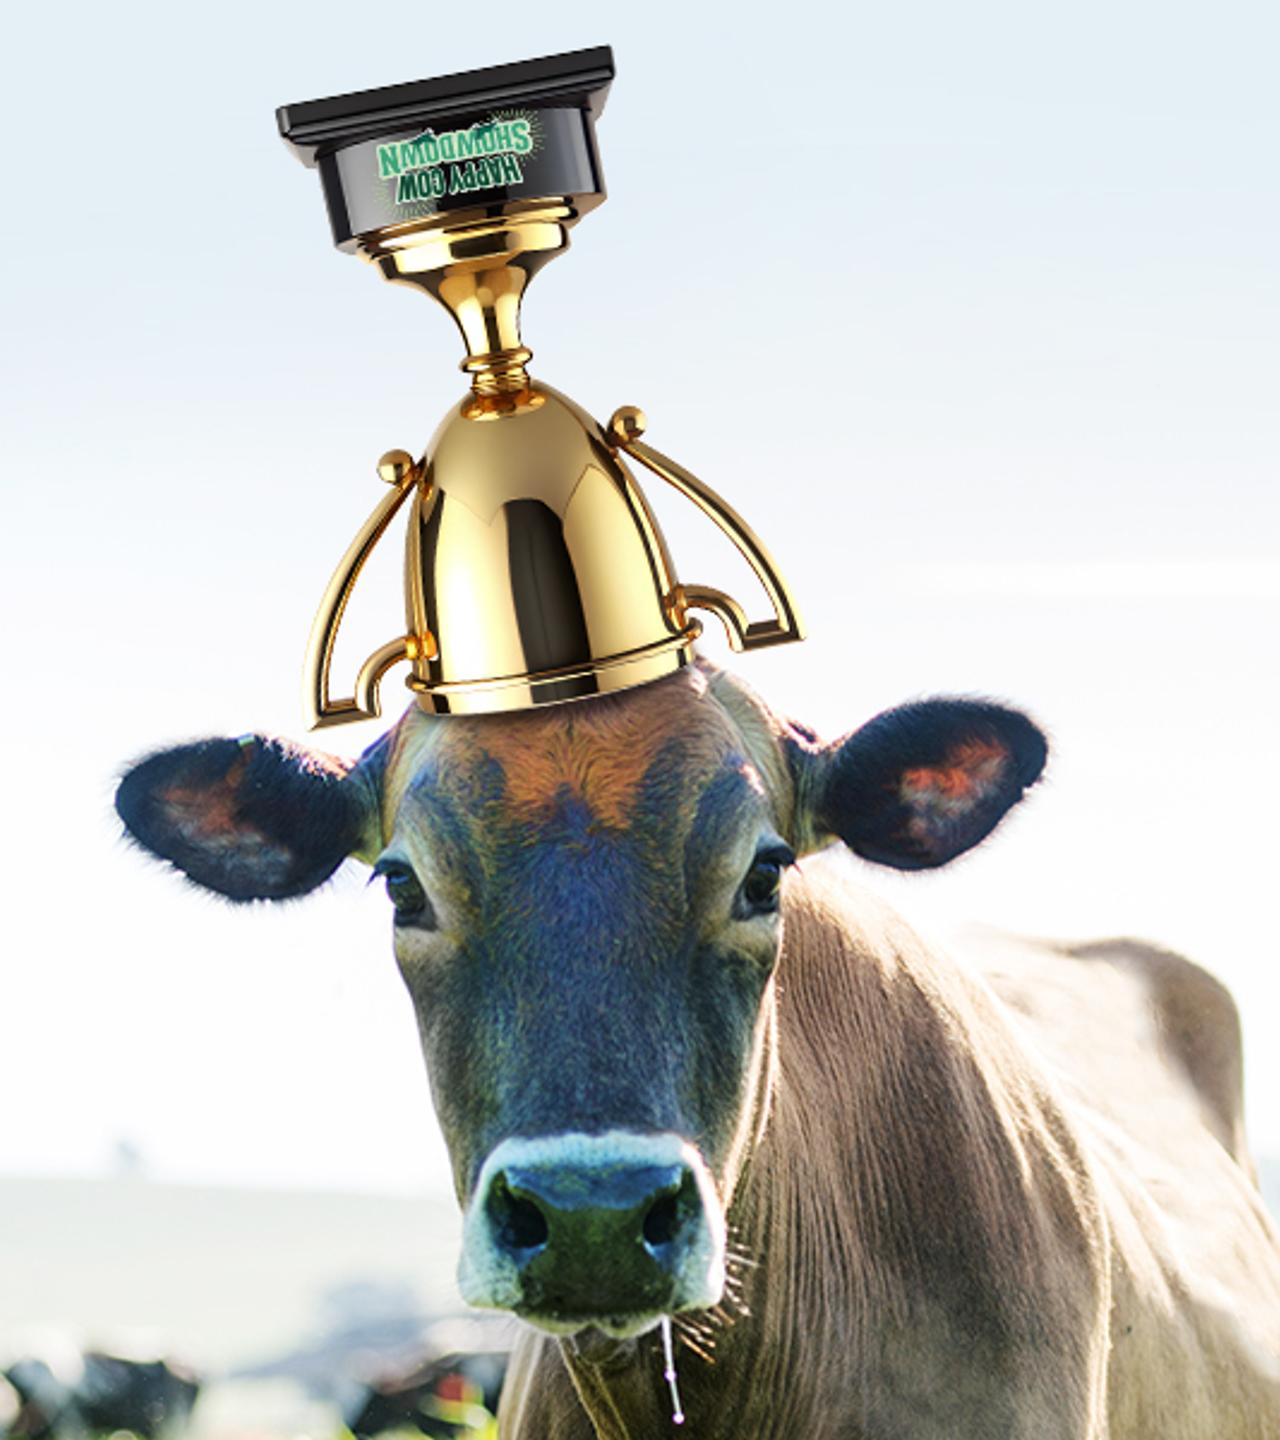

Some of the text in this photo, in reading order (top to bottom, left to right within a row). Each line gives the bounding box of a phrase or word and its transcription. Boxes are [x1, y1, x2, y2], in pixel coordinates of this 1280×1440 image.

[378, 119, 531, 178] SHOWDOWN
[397, 154, 522, 202] HAPPY COW
